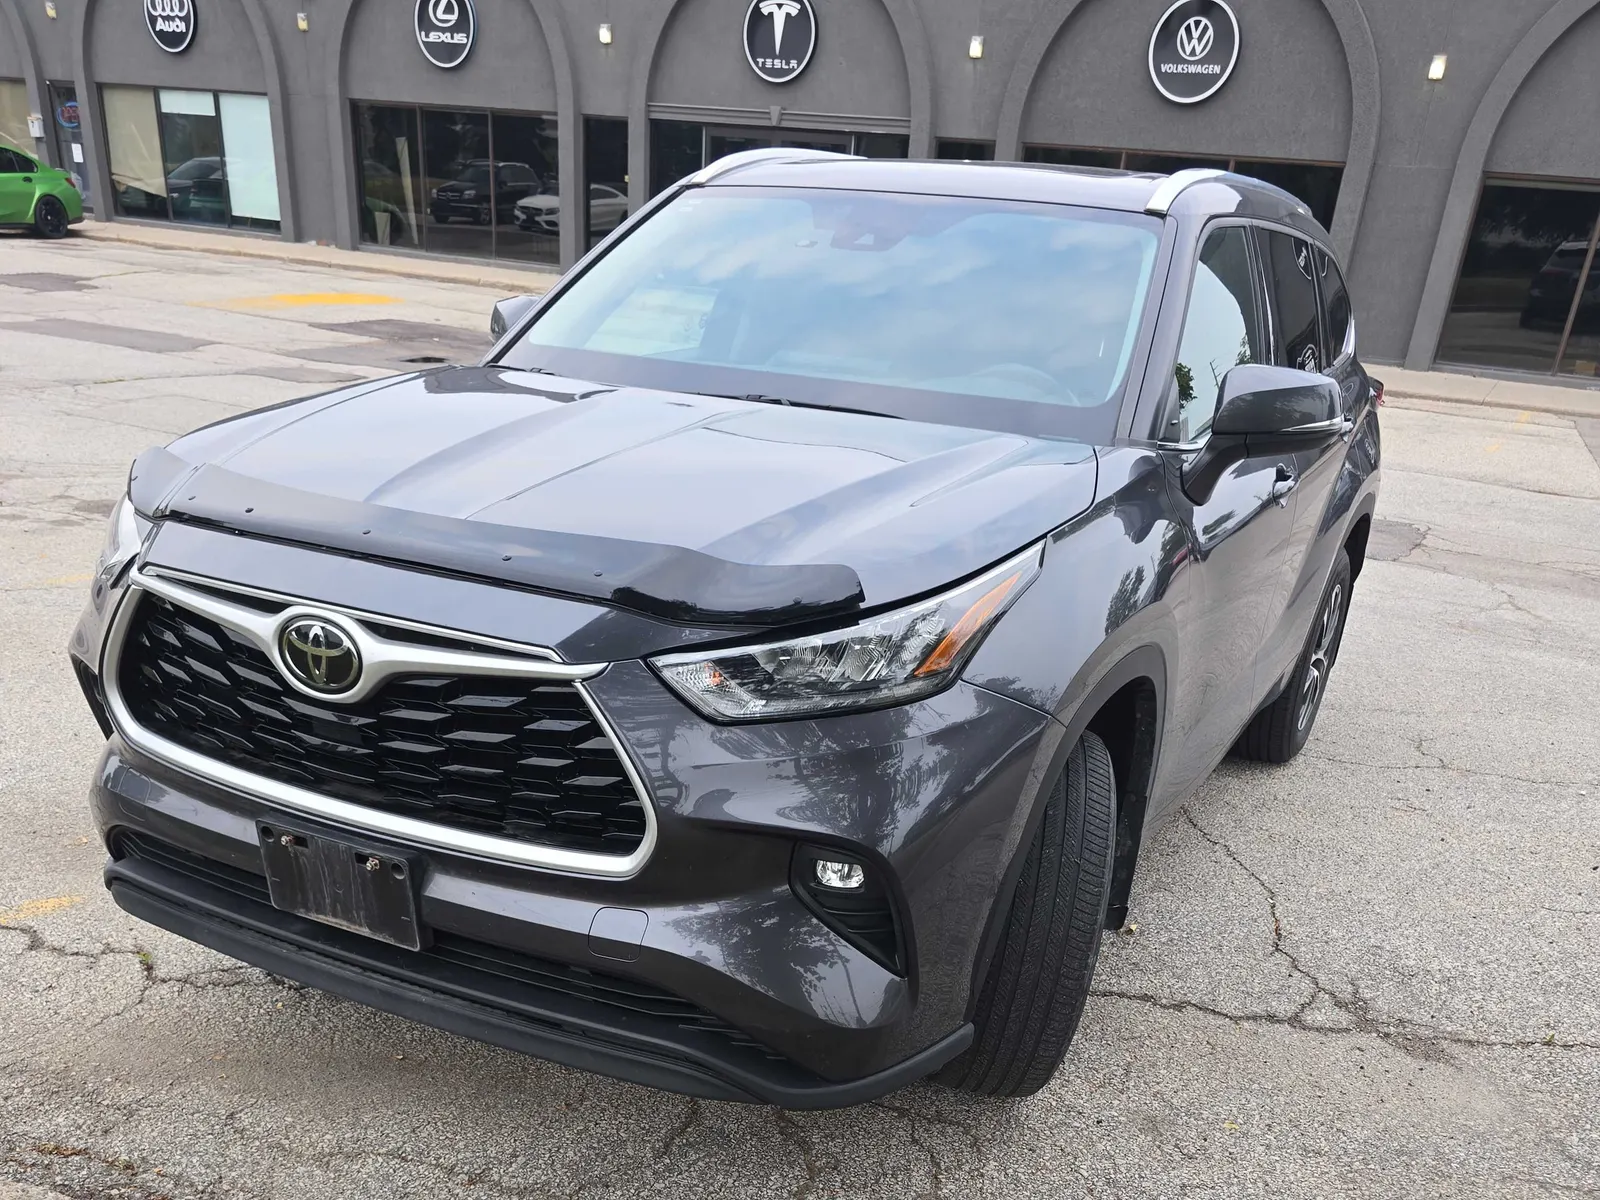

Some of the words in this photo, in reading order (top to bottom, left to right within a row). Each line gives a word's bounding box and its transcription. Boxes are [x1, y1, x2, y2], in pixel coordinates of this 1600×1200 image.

[156, 16, 186, 32] Audi
[421, 31, 468, 44] LEXUS
[756, 58, 798, 69] TESLA
[1160, 64, 1221, 74] VOLKSWAGEN
